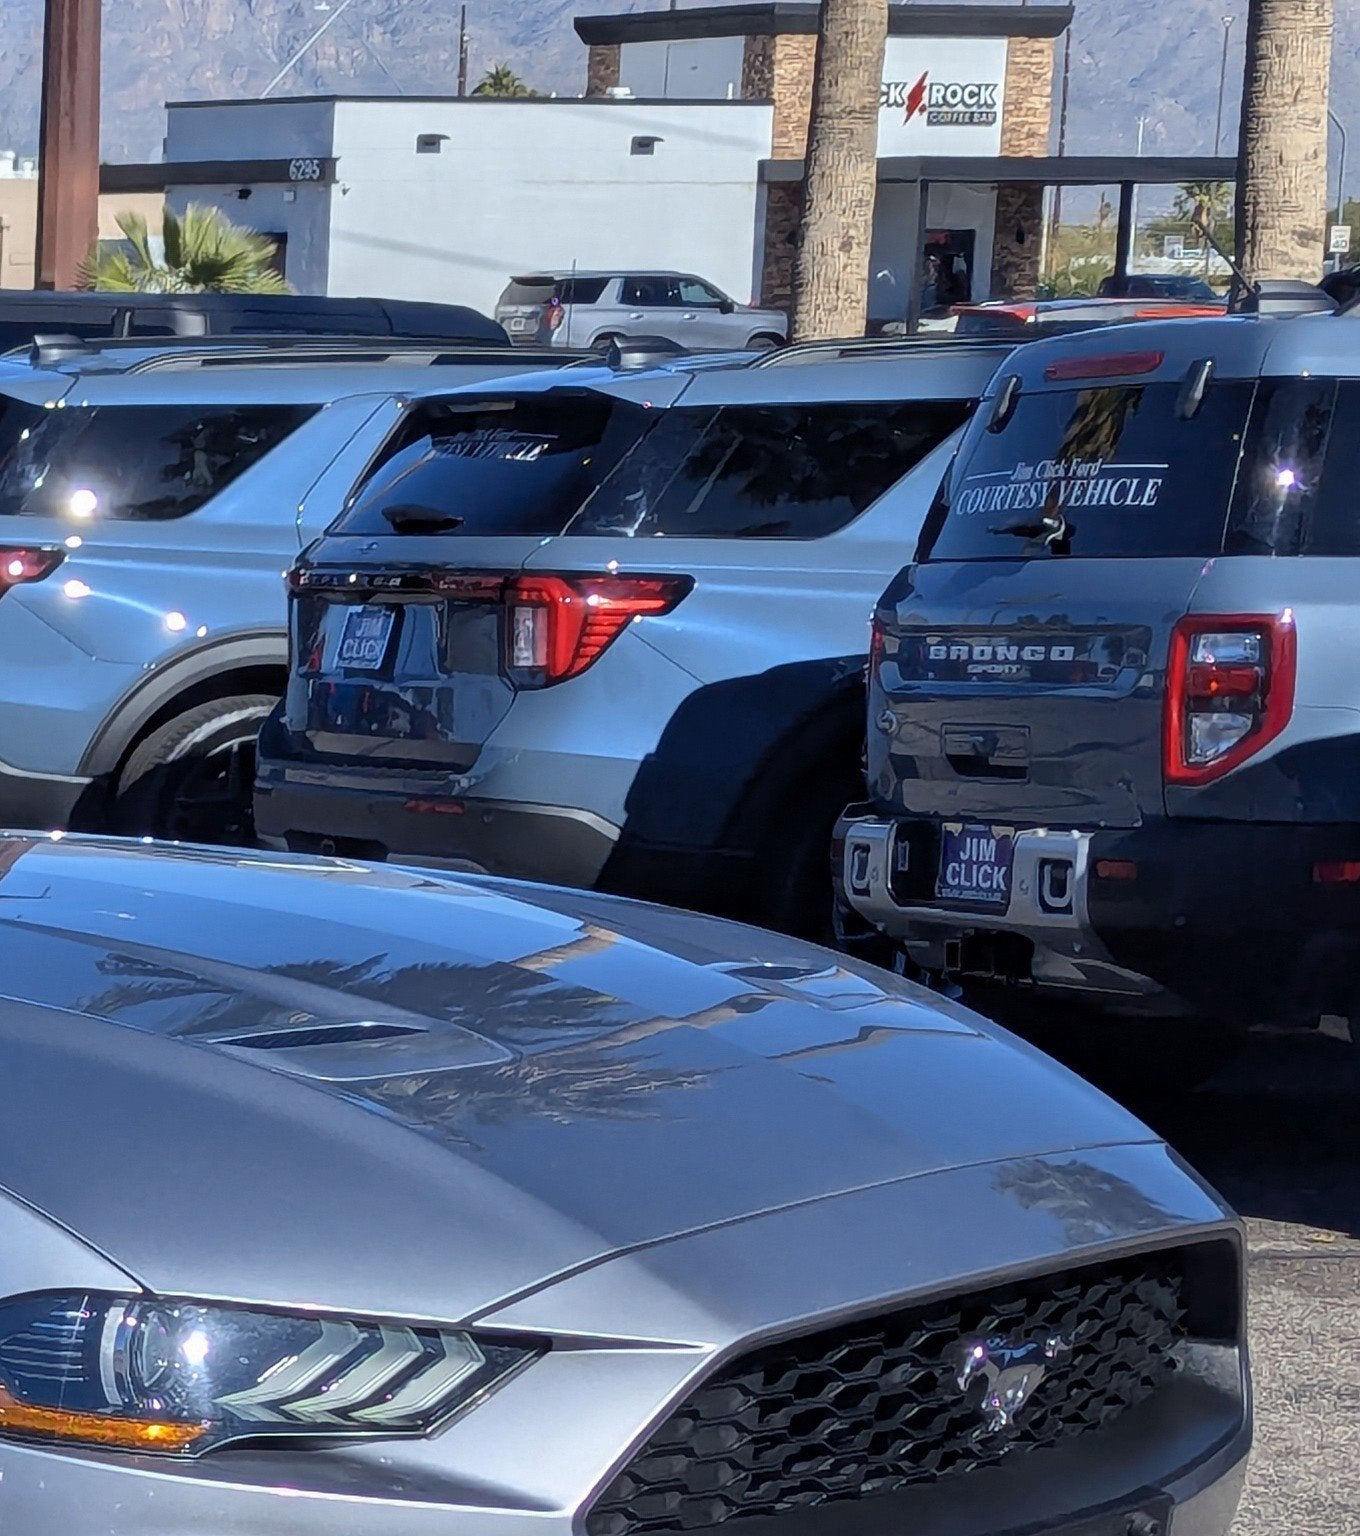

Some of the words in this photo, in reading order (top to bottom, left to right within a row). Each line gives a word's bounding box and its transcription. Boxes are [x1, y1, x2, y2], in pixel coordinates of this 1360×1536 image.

[928, 83, 998, 108] ROCK
[1069, 457, 1103, 477] Ford
[956, 481, 1055, 515] COURTESY
[1056, 477, 1163, 508] VEHICLE
[928, 645, 1076, 661] BRONCO
[966, 664, 1021, 674] SPORT
[960, 837, 996, 862] JIM
[946, 862, 1007, 890] CLICK
